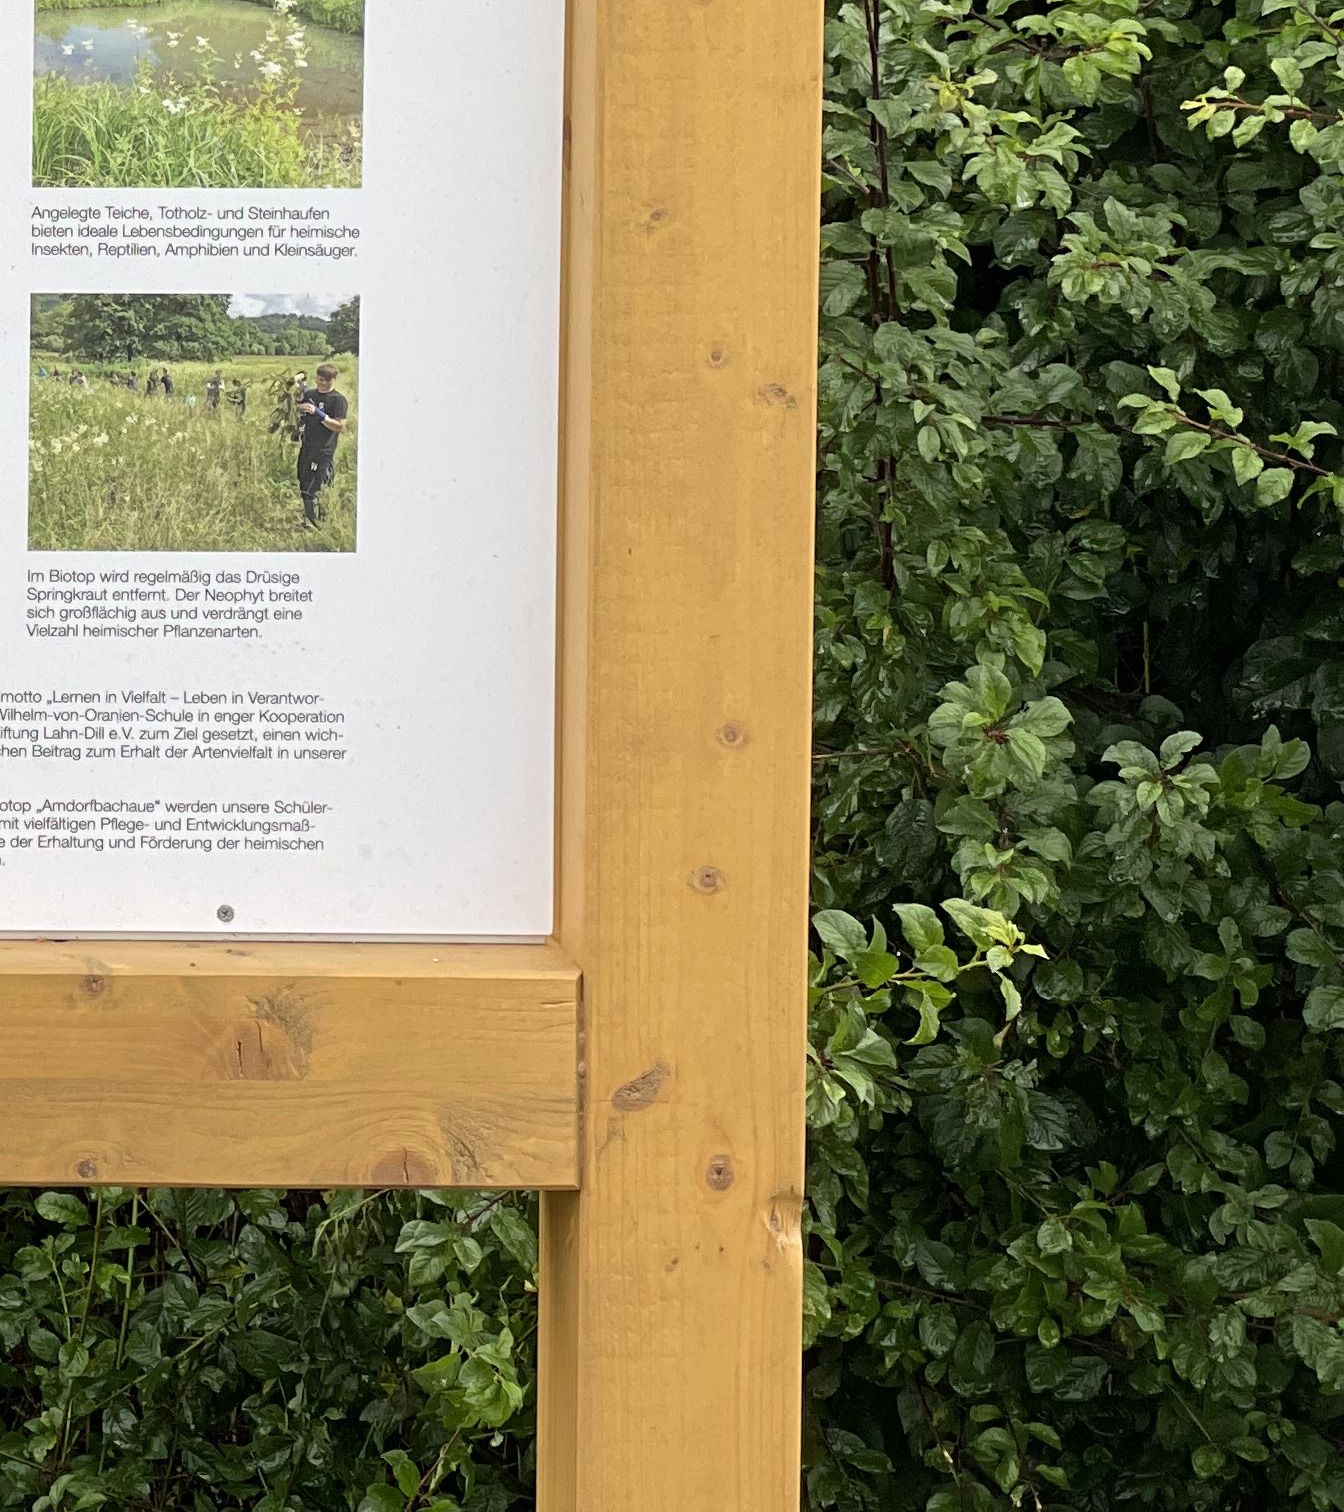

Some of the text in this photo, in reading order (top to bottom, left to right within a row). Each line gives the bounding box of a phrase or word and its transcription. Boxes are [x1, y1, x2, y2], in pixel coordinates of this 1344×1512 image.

[30, 205, 330, 223] Angelegte Teiche, Totholz- und Steinhaufen
[31, 223, 361, 242] bieten ideale Lebensbedingungen für heimische
[31, 242, 359, 261] Insekten, Reptilien, Amphibien und Kleinsäuger.
[27, 568, 301, 588] Im Biotop wird regelmäßig das Drüsige
[197, 708, 210, 723] in
[213, 711, 256, 726] enger
[258, 708, 345, 726] Kooperation
